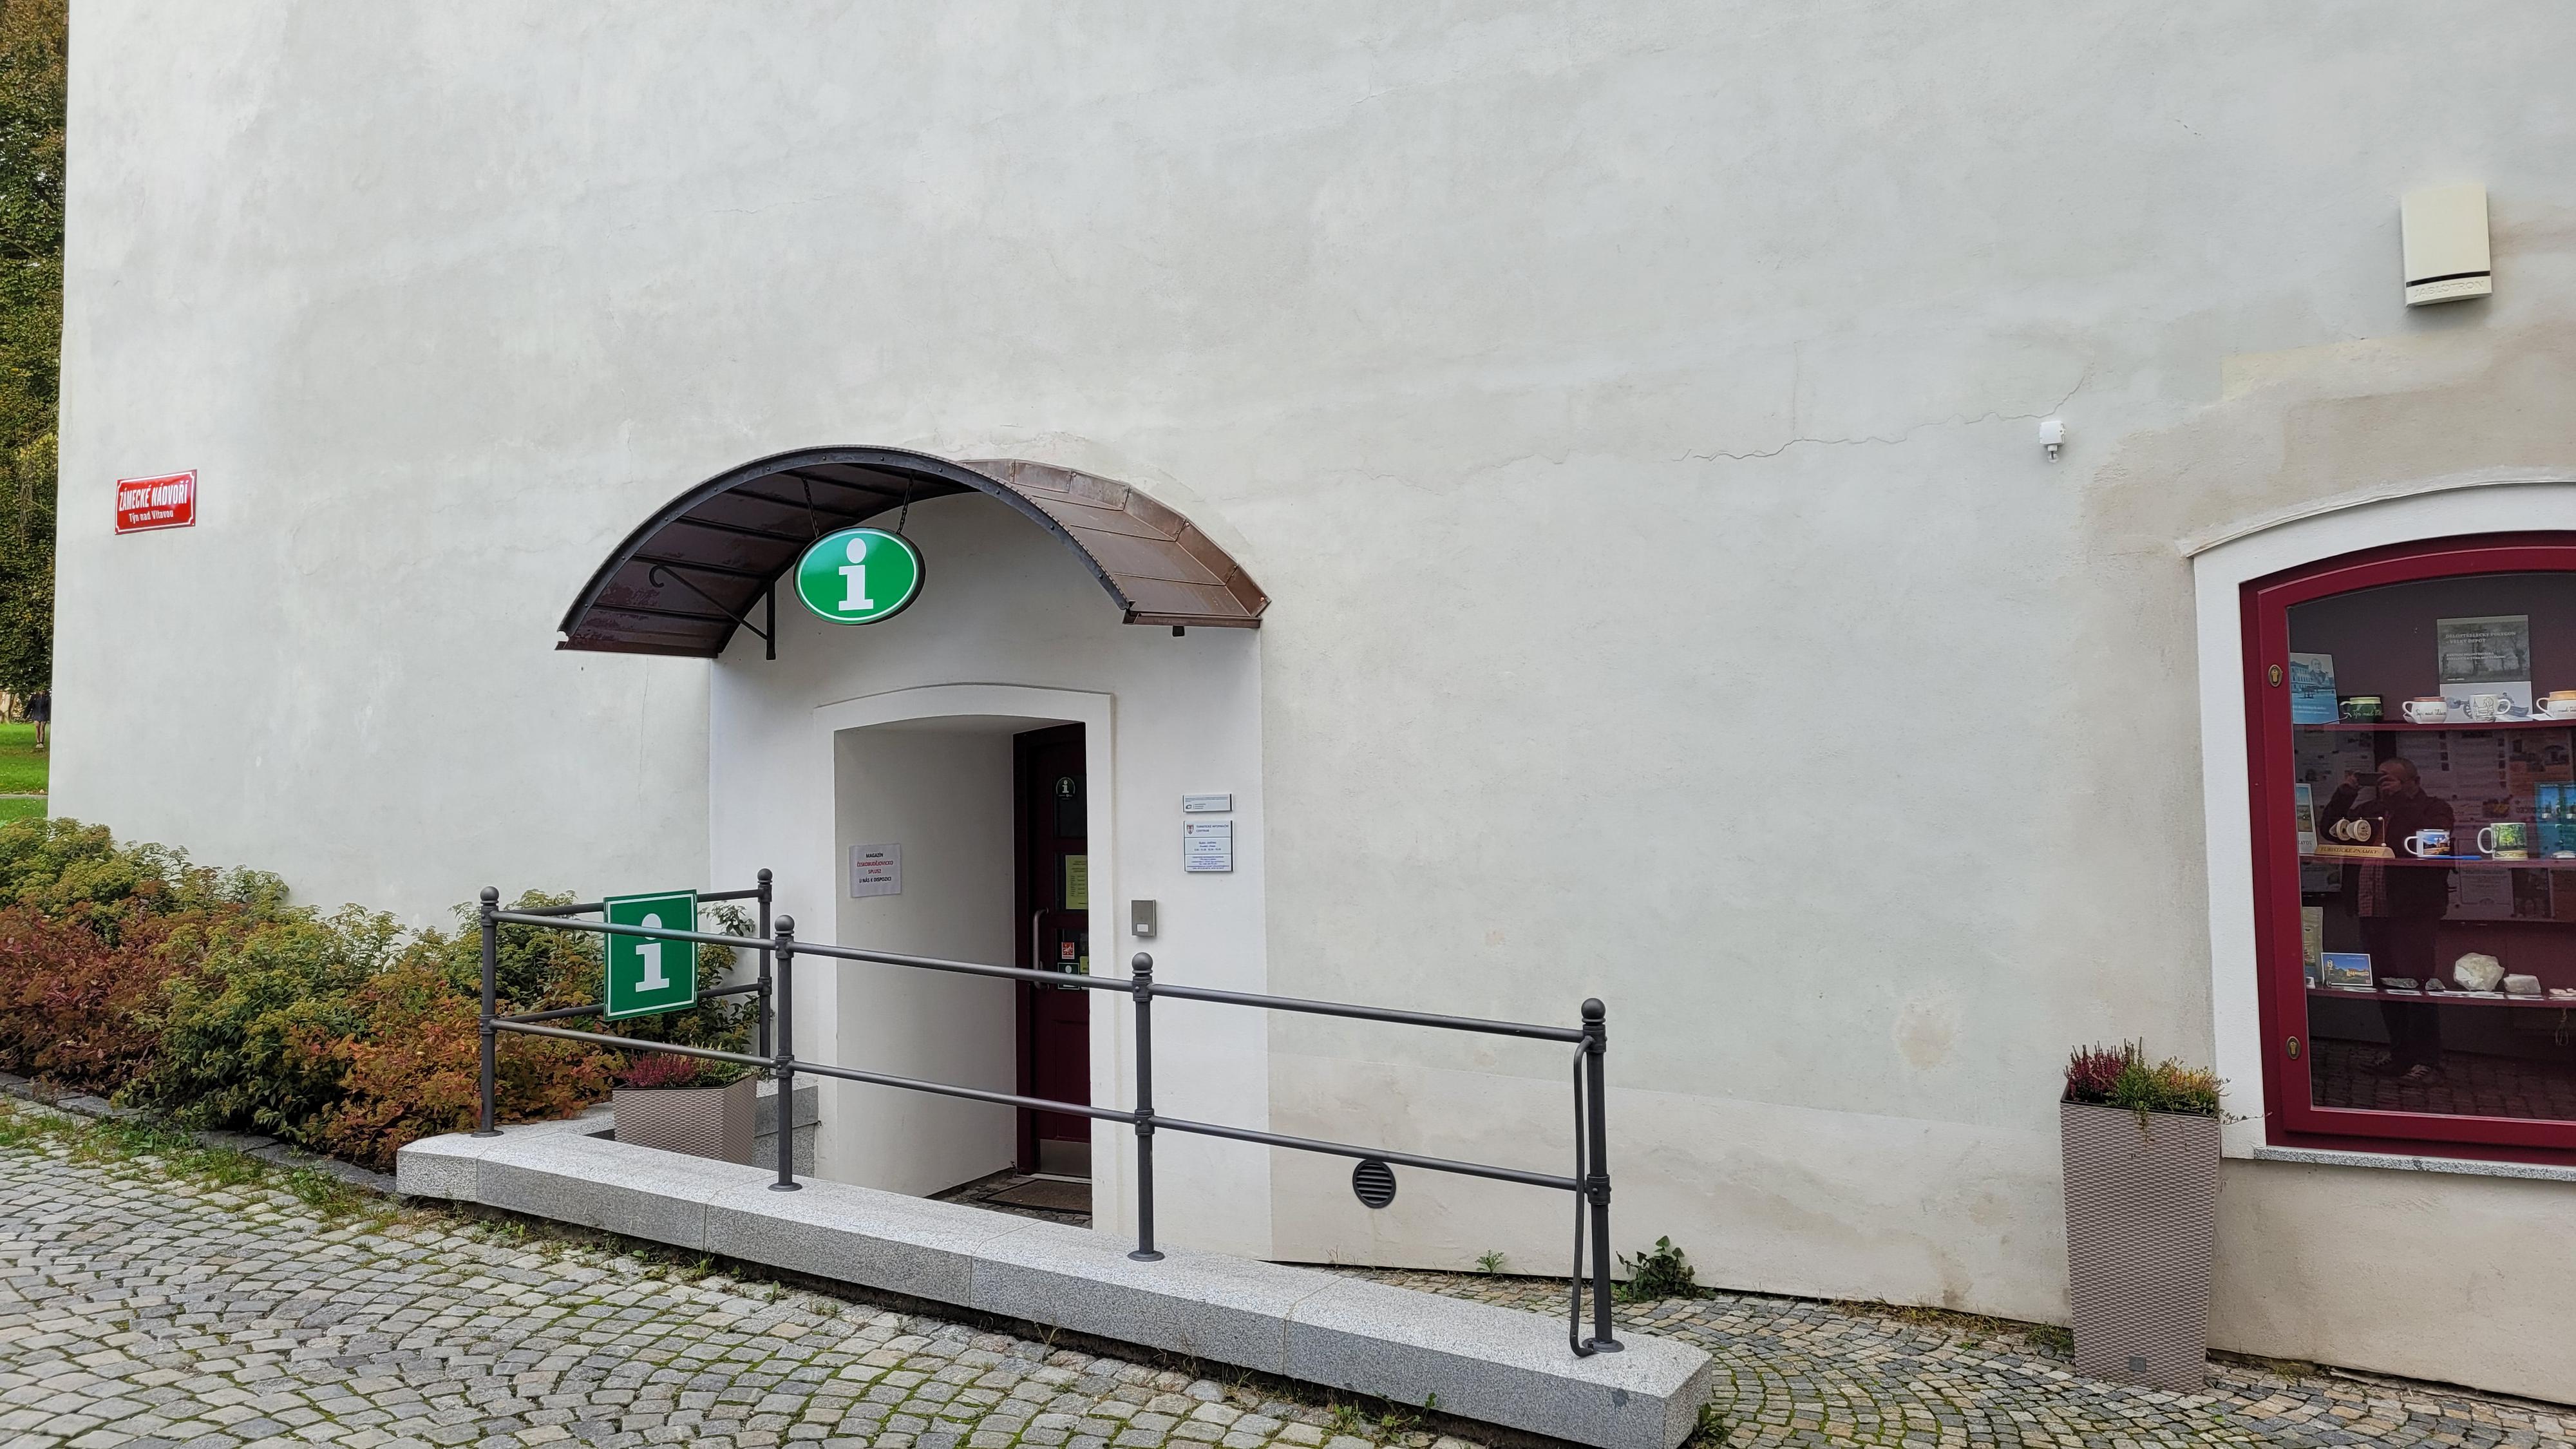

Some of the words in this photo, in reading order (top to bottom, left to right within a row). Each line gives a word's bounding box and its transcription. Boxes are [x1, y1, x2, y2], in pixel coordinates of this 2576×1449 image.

[2414, 280, 2484, 298] JABLOTRON
[118, 485, 151, 511] ZÁMECKÉ
[152, 480, 188, 506] NÁDVOŘÍ
[129, 513, 139, 524] Týn
[140, 512, 151, 521] nad
[151, 509, 173, 520] Vltavou
